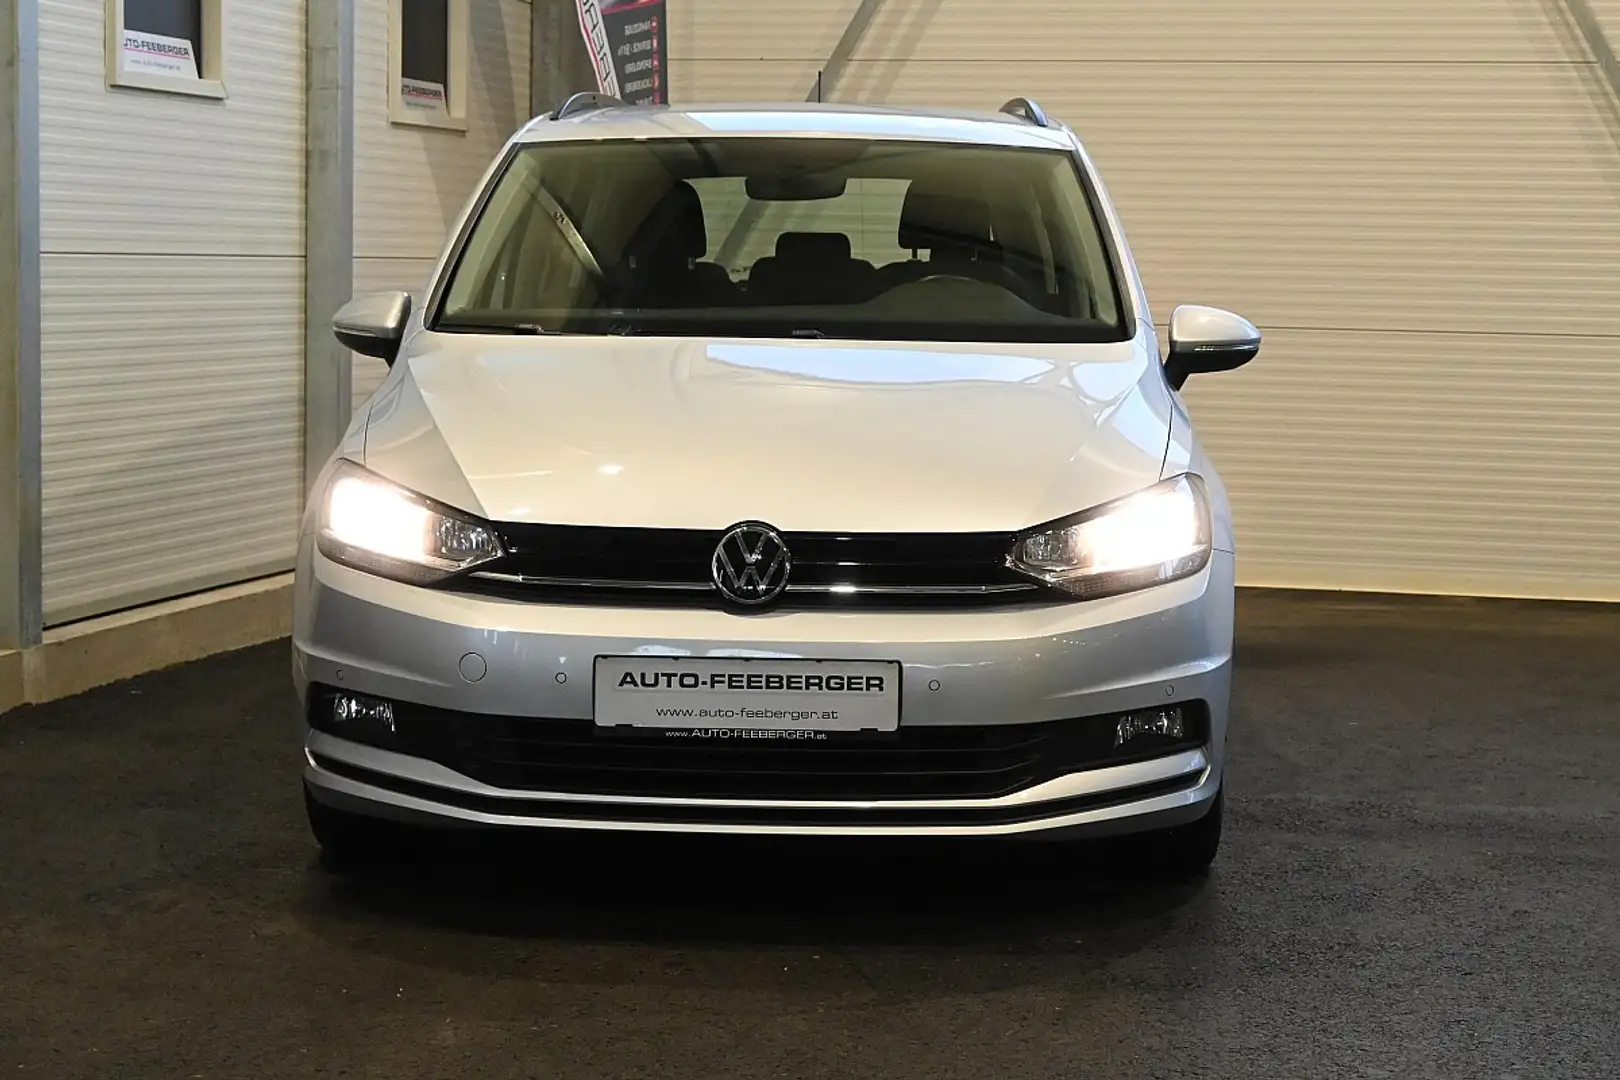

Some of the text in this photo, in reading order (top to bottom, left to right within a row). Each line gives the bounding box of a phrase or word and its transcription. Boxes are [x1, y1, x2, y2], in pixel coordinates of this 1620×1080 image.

[617, 671, 885, 692] AUTO-FEEBERGER
[656, 707, 838, 721] www.auto-feeberger.at
[665, 729, 828, 740] www.AUTO-FEEBERGER.at
